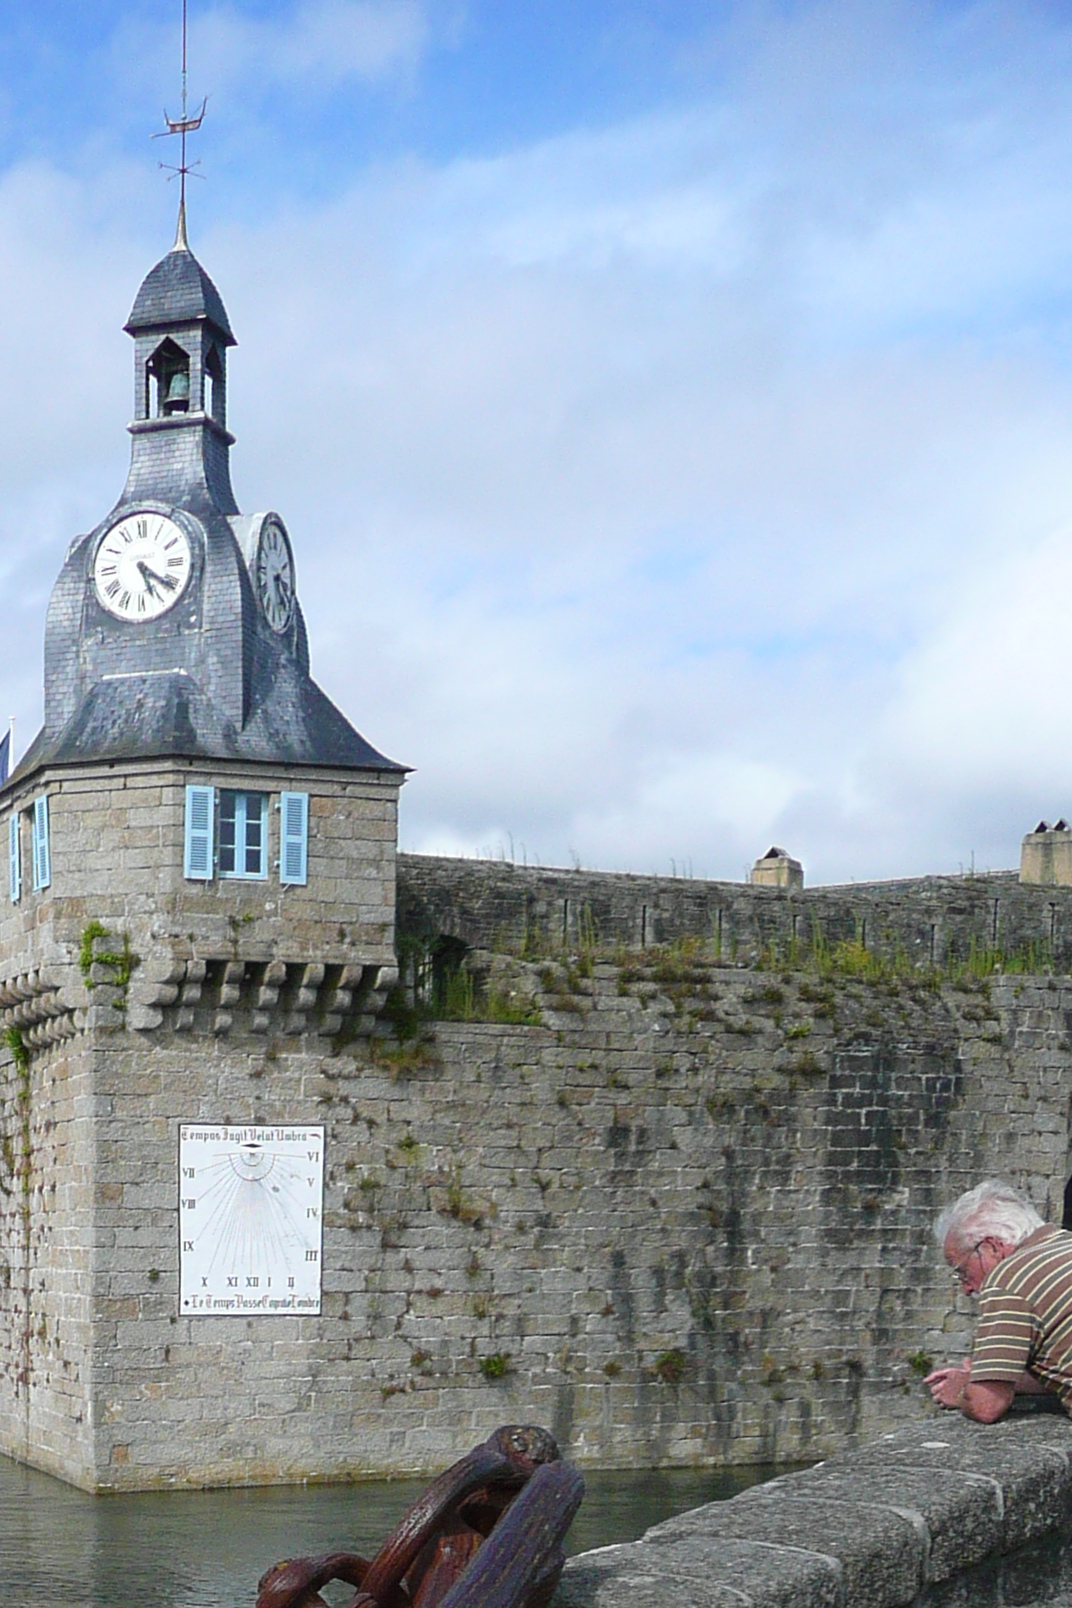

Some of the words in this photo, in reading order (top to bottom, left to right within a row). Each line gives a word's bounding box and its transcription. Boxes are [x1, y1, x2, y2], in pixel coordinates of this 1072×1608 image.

[181, 1127, 220, 1143] Tempus
[275, 1128, 307, 1141] Umbra
[307, 1152, 320, 1162] VI
[182, 1168, 195, 1178] VII
[307, 1178, 315, 1187] V
[181, 1199, 196, 1209] VIII
[306, 1208, 318, 1218] IV
[183, 1241, 195, 1251] IX
[305, 1250, 319, 1261] III
[201, 1277, 208, 1287] X
[226, 1277, 238, 1287] XI
[245, 1277, 259, 1287] XII
[205, 1294, 235, 1309] Temps
[234, 1294, 261, 1308] Passe
